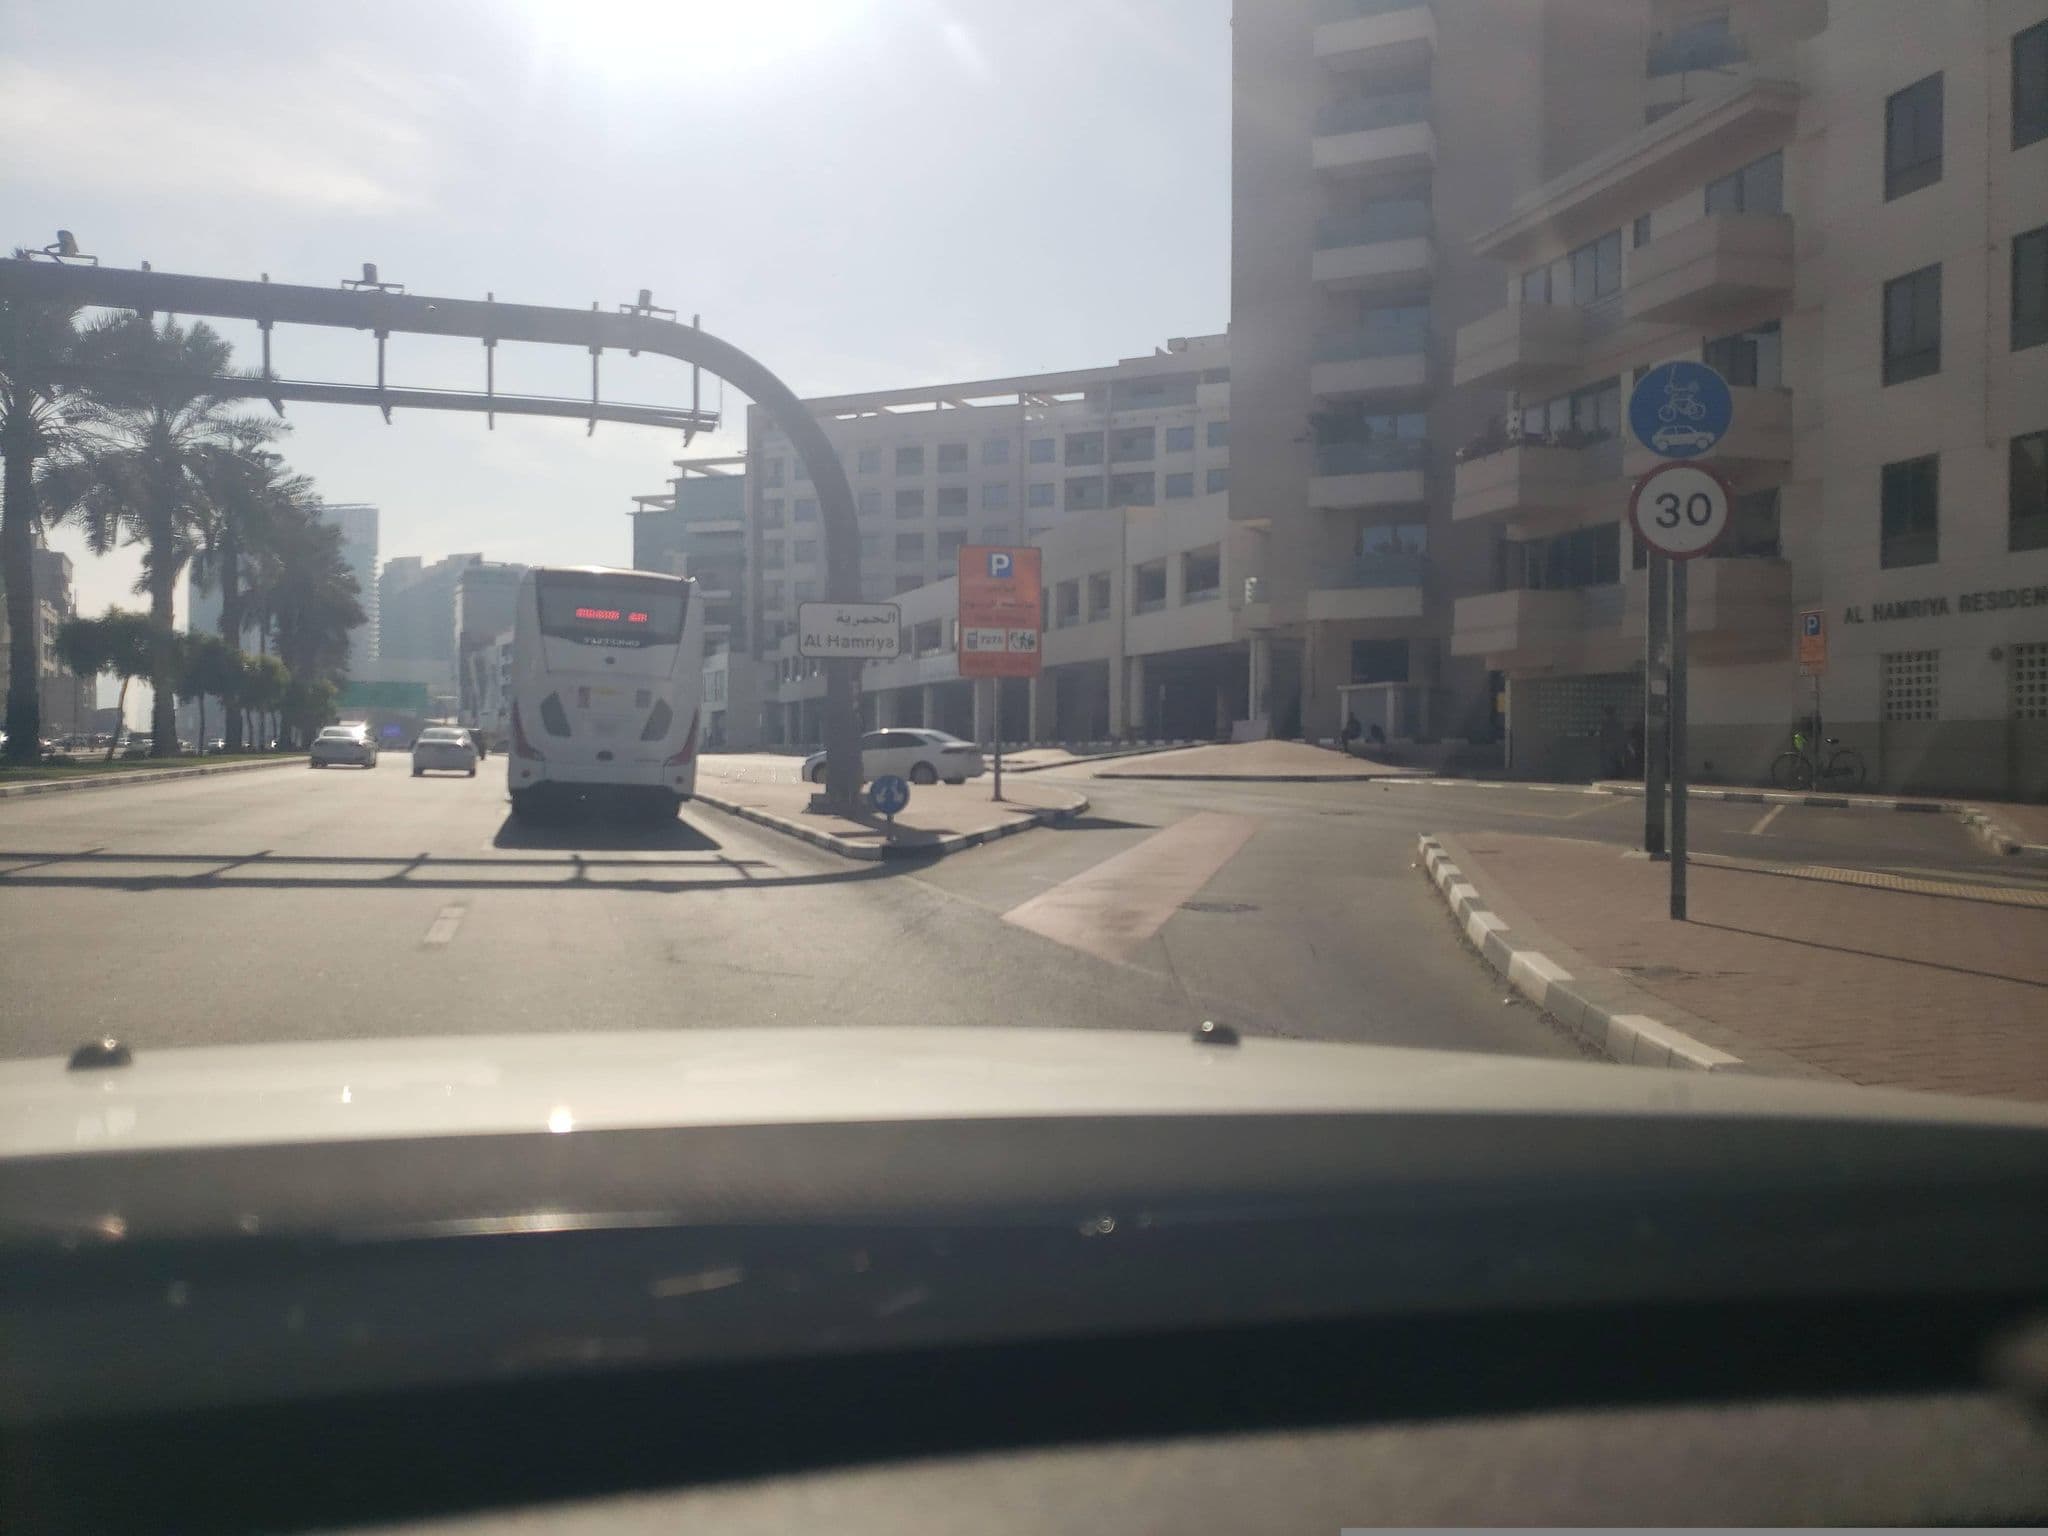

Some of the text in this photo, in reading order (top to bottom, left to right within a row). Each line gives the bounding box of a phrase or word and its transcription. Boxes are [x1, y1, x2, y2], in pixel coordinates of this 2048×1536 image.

[1655, 493, 1712, 528] 30
[992, 553, 1009, 576] P
[836, 609, 896, 626] الحمرية
[1843, 606, 1864, 624] AL
[1872, 597, 1950, 623] HAMRIYA
[1807, 615, 1818, 634] P
[804, 632, 895, 651] Al Hamriya
